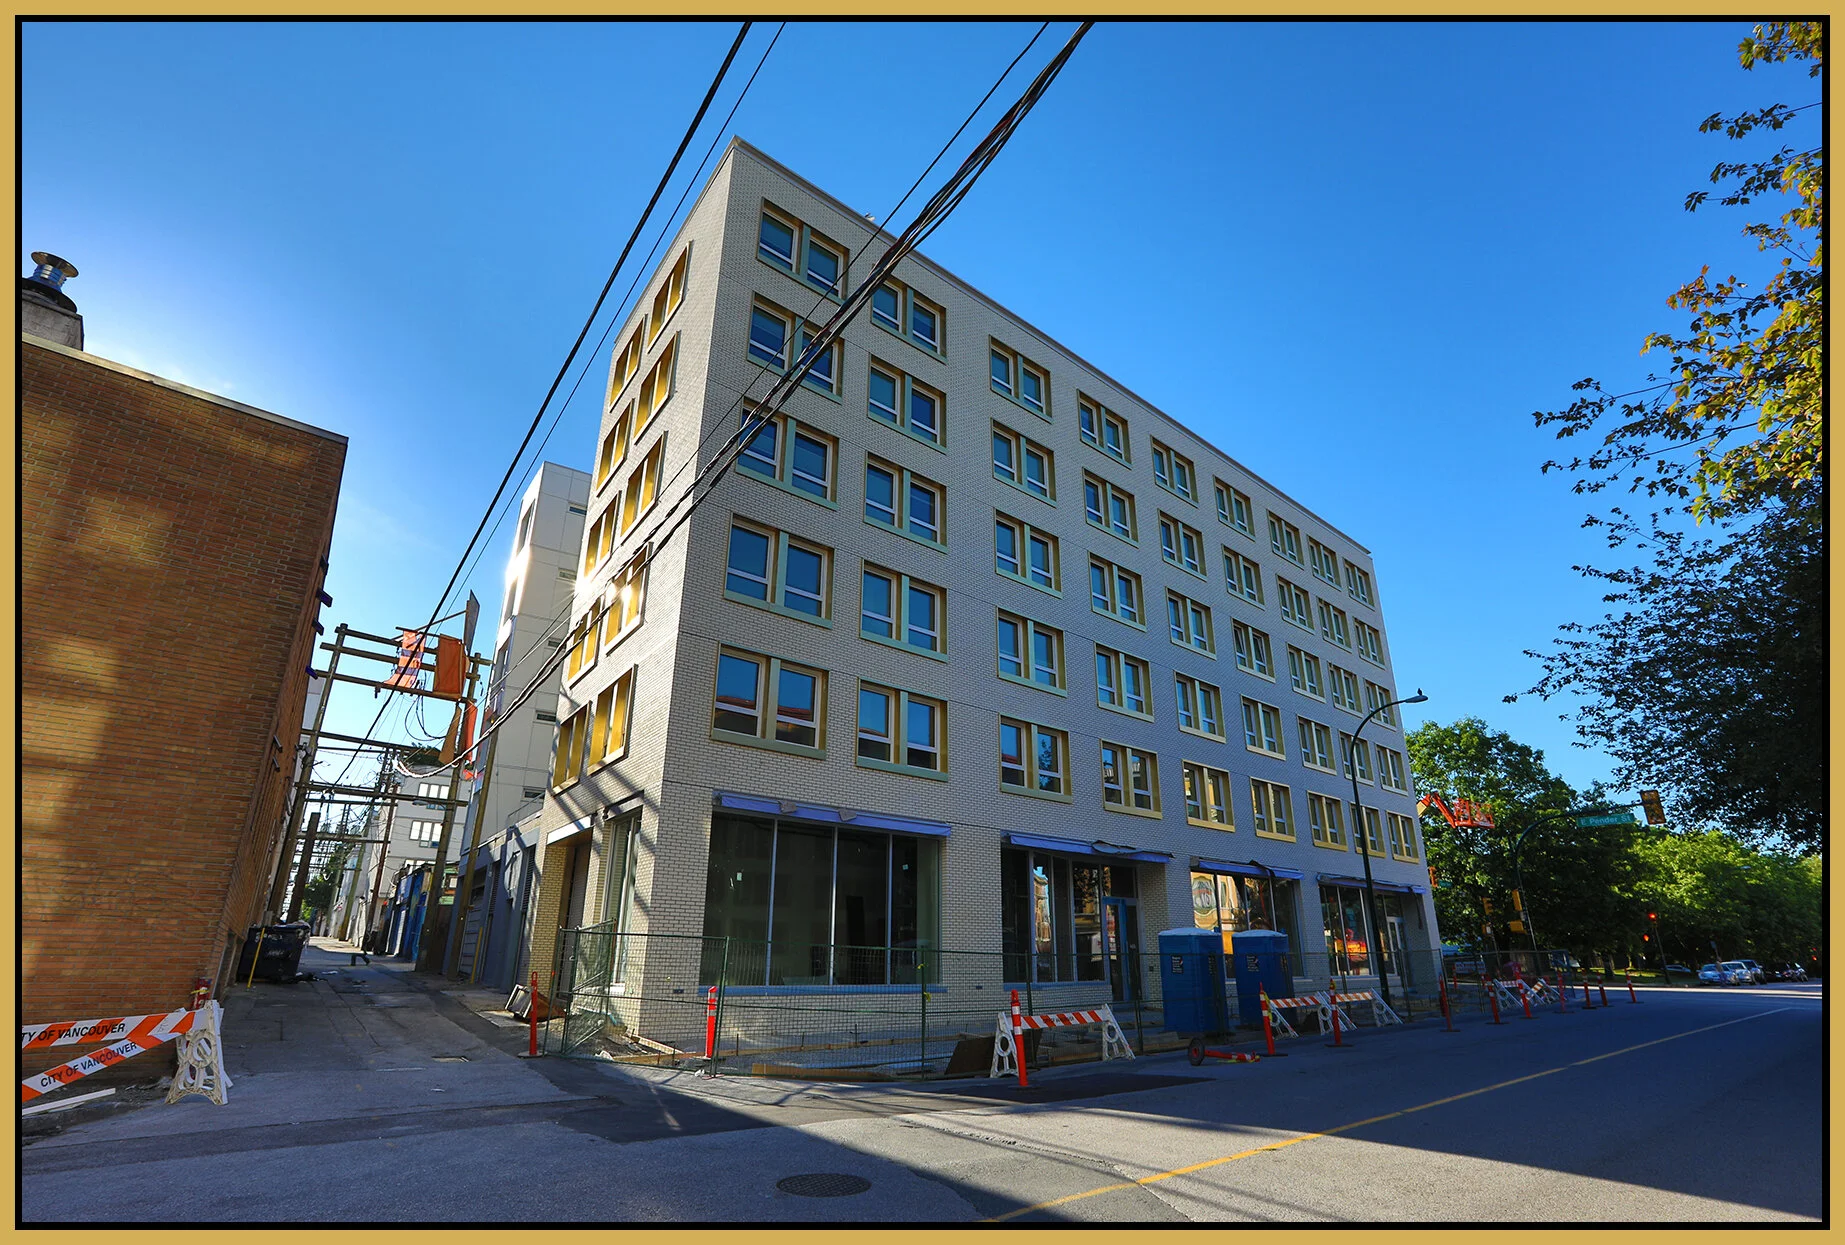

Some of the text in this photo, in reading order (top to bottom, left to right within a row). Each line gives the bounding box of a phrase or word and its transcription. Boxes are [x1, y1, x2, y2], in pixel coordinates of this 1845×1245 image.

[1590, 817, 1618, 825] Pender
[38, 1029, 55, 1041] OF
[57, 1023, 126, 1038] VANCOUVER
[40, 1042, 138, 1087] CITY OF VANCOUVER
